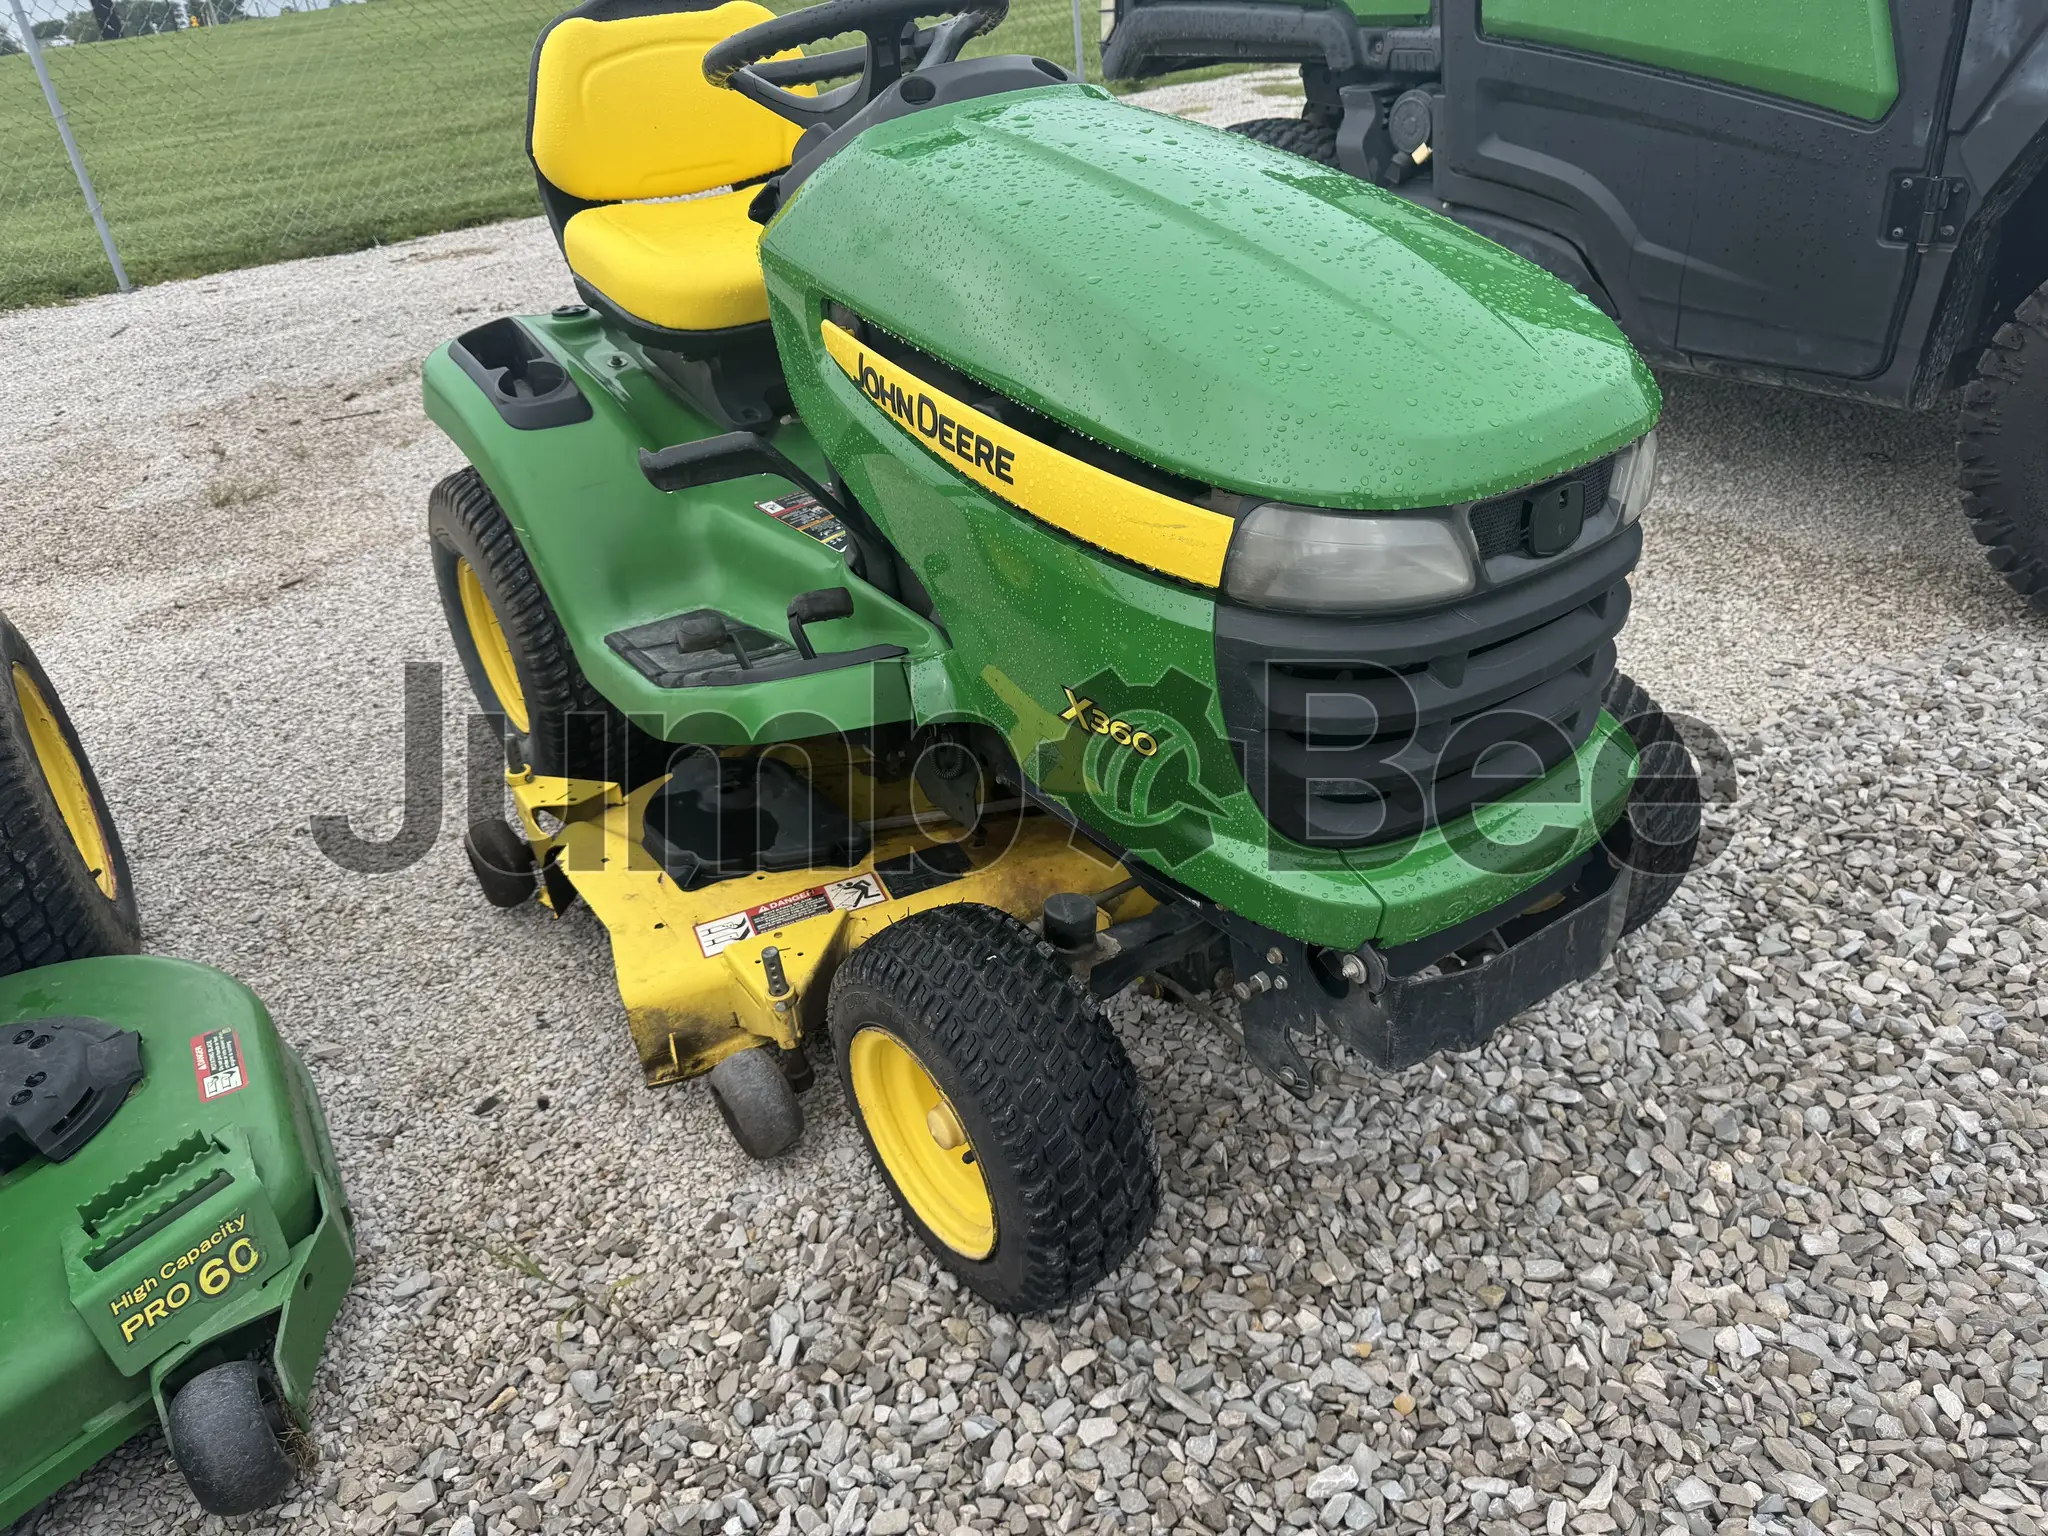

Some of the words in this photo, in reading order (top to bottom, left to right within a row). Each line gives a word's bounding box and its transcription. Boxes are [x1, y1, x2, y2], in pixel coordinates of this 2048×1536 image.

[853, 352, 914, 427] JOHN
[918, 393, 1015, 485] DEERE
[1058, 685, 1158, 757] X360
[110, 1277, 158, 1316] High
[160, 1214, 245, 1280] Capacity
[120, 1282, 190, 1343] PRO
[199, 1237, 259, 1295] 60
